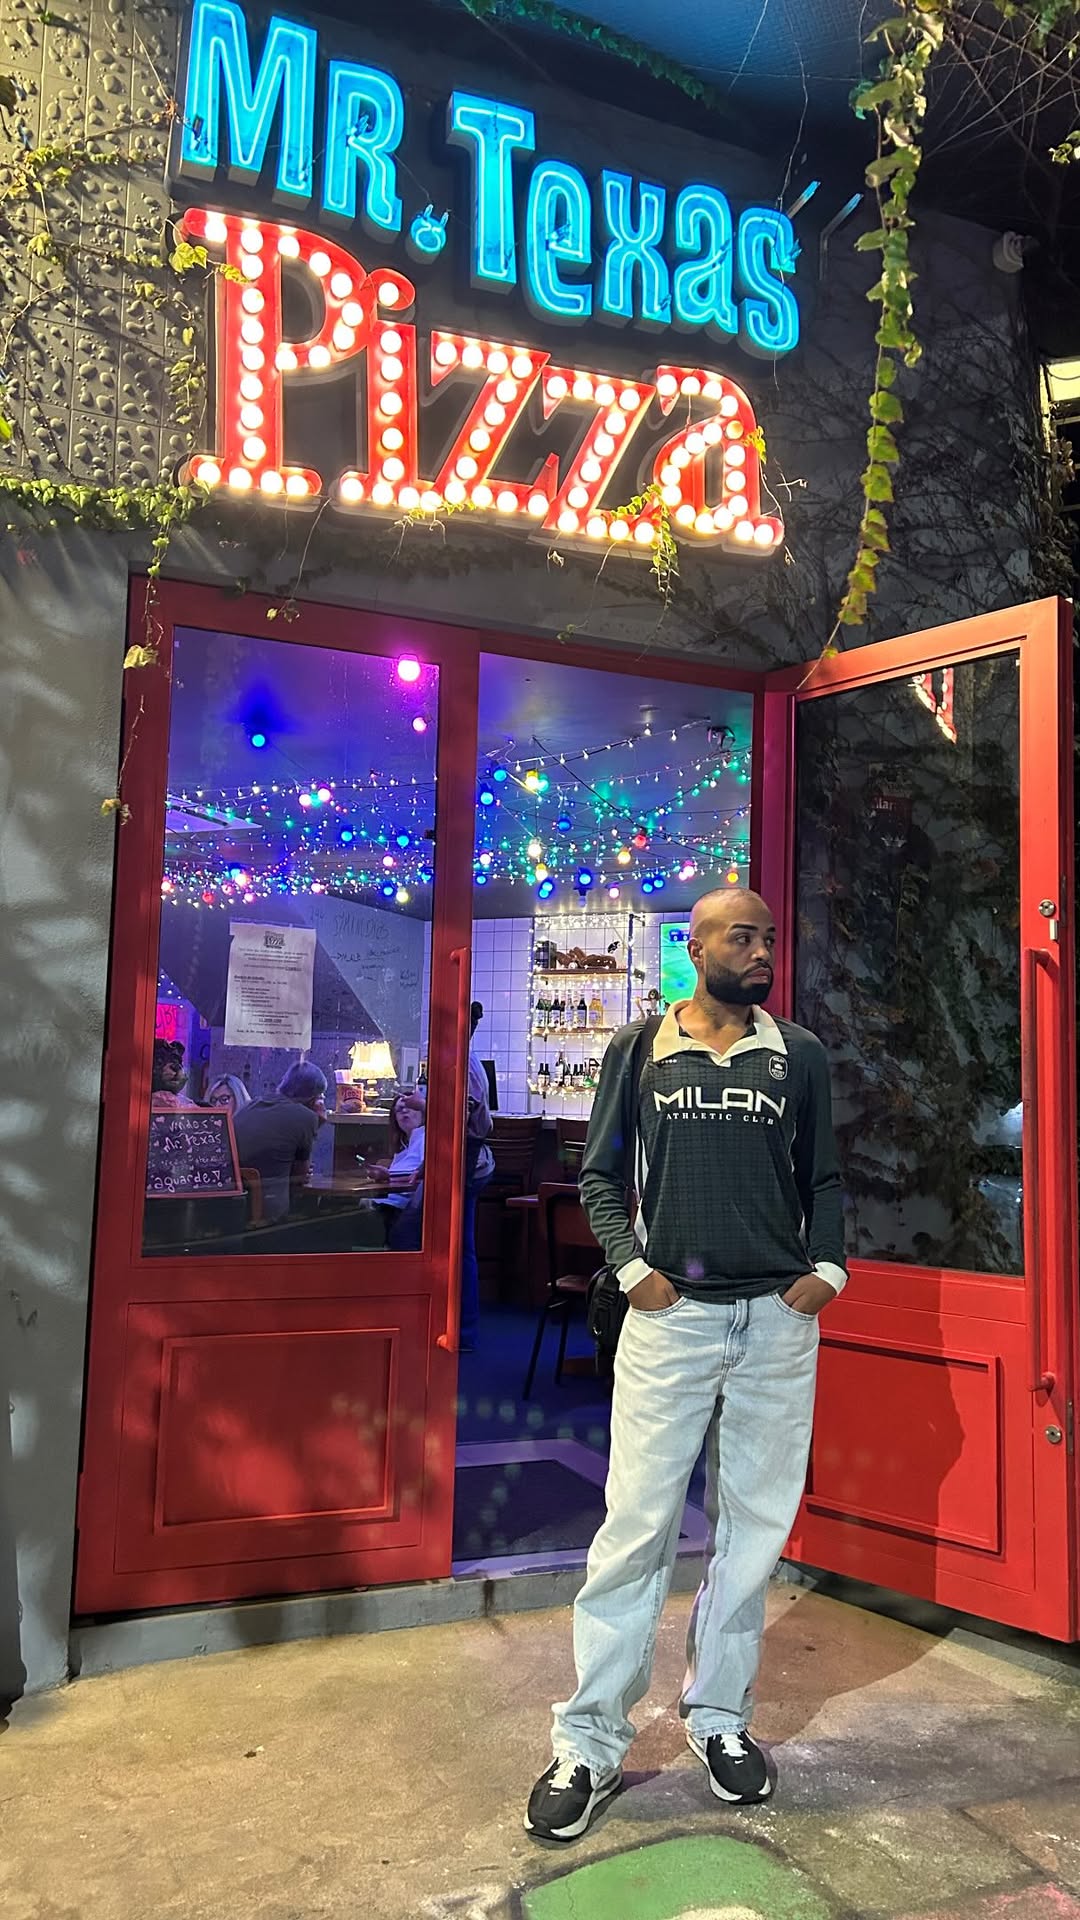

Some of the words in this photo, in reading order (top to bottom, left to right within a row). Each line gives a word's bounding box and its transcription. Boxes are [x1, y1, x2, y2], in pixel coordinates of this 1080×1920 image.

[445, 90, 800, 353] Texas
[183, 207, 785, 546] Pizza
[653, 1086, 787, 1118] MILAN
[666, 1112, 733, 1121] ATHLETIC
